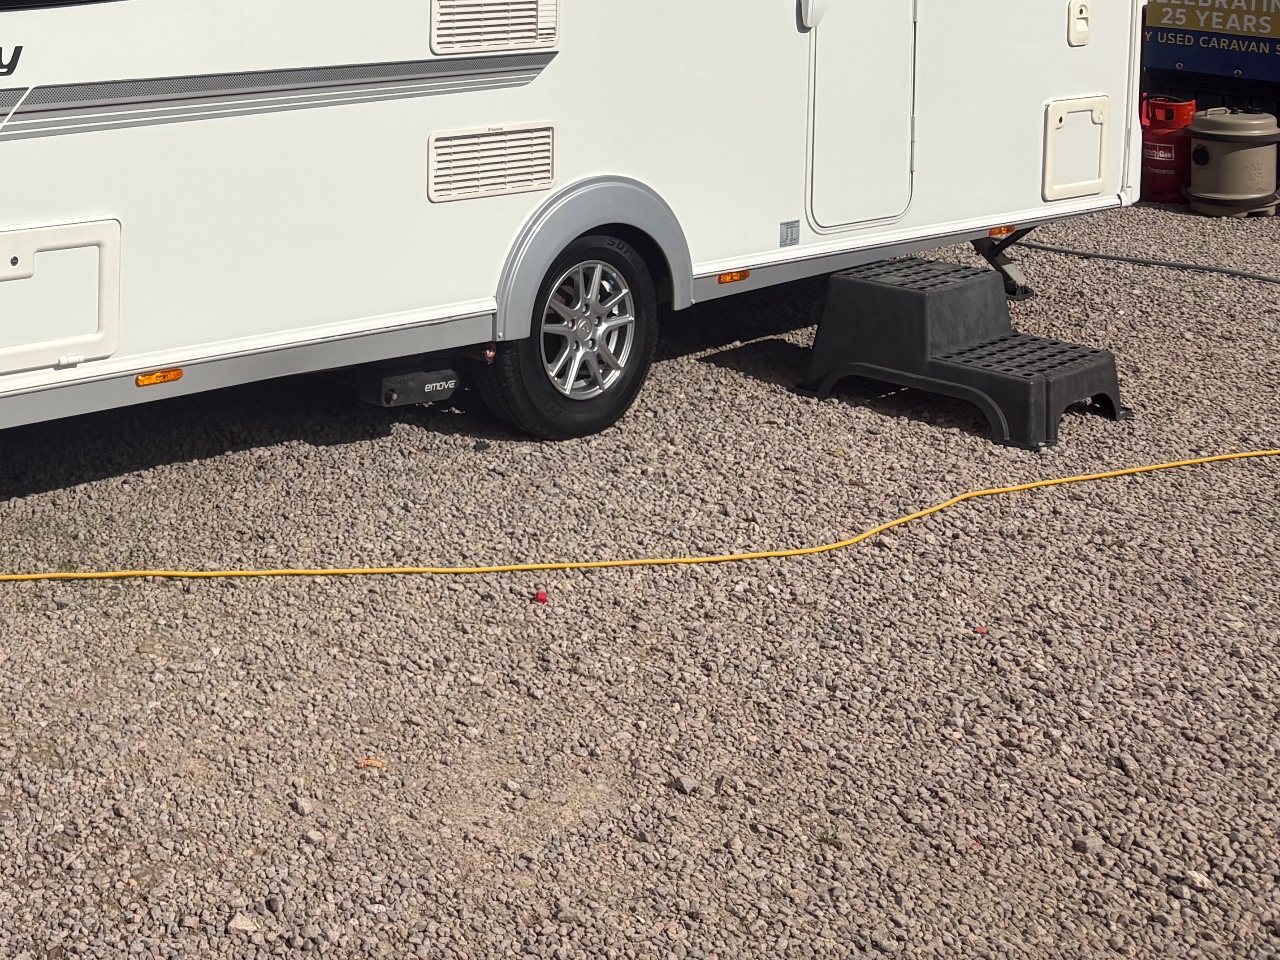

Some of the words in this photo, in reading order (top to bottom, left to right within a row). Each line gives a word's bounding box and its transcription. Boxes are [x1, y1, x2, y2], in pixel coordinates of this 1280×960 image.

[1161, 7, 1187, 25] 25
[1195, 9, 1272, 34] YEARS
[1157, 32, 1194, 46] USED
[1199, 36, 1269, 54] CARAVAN
[424, 380, 457, 392] emove
